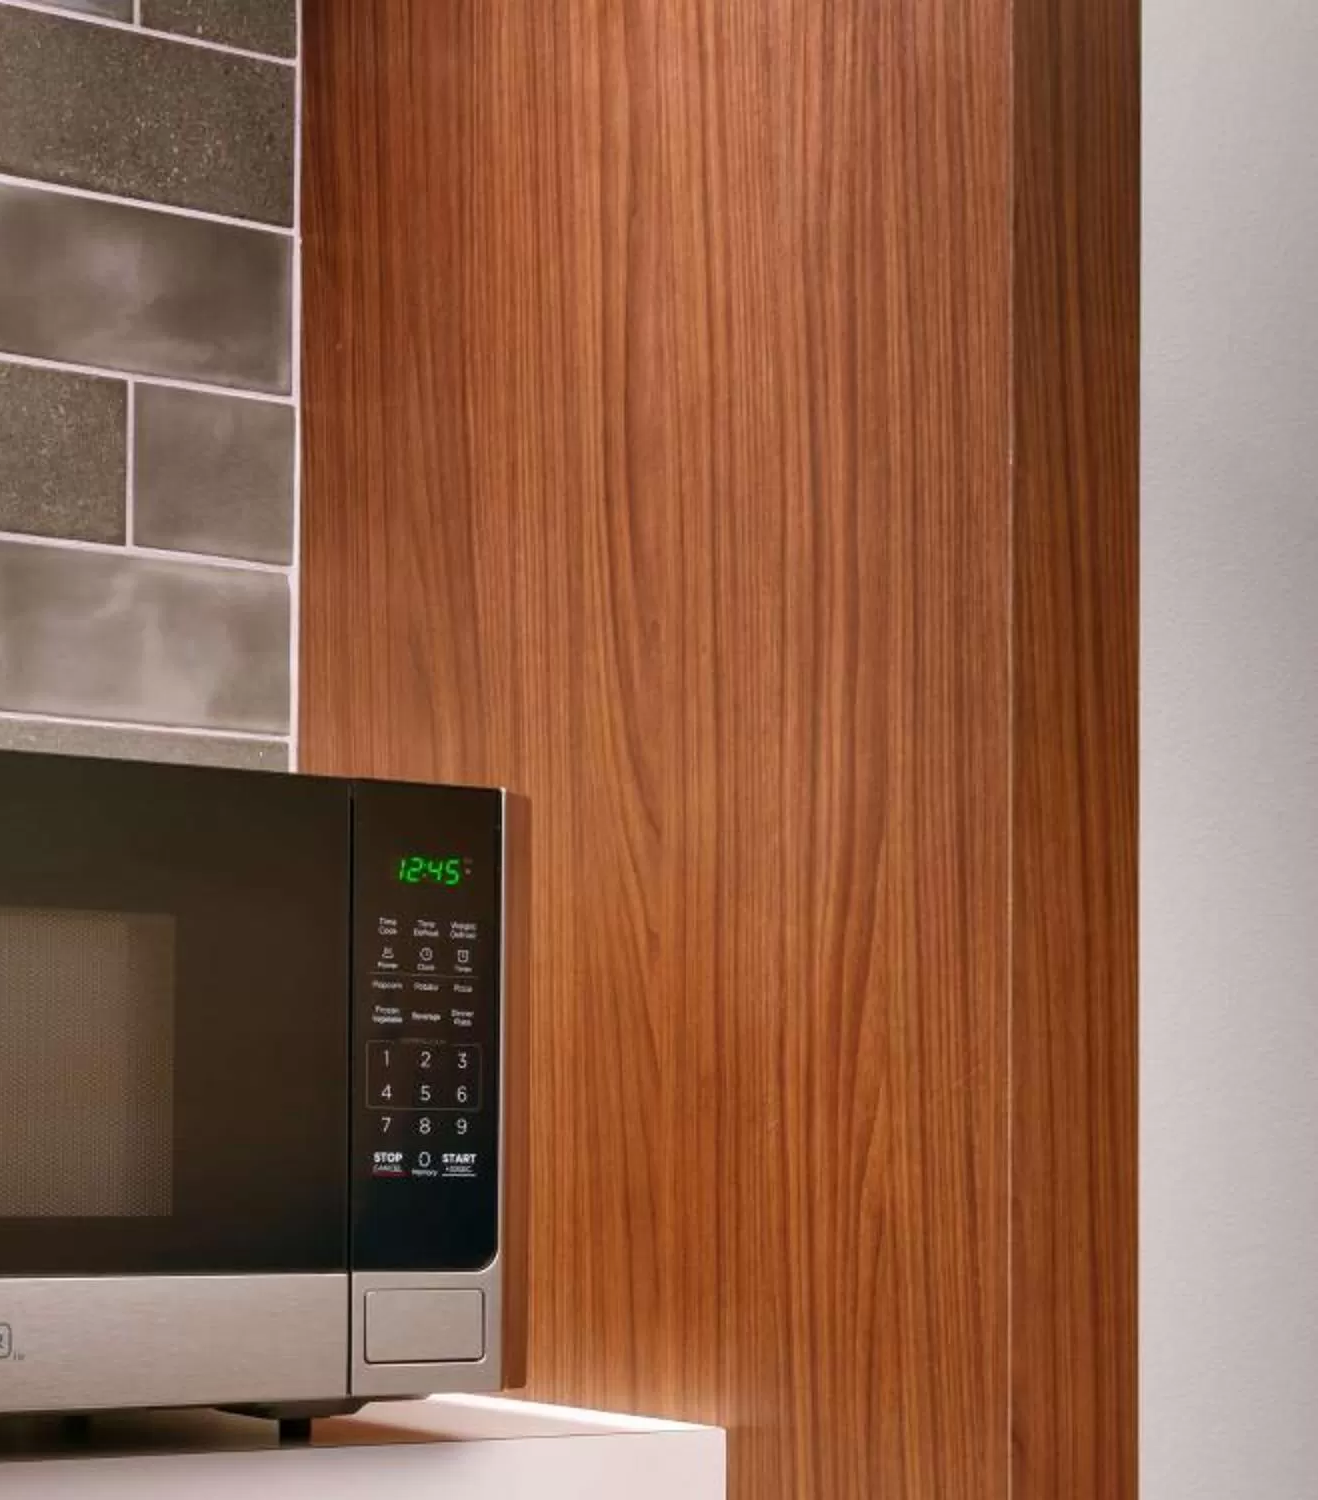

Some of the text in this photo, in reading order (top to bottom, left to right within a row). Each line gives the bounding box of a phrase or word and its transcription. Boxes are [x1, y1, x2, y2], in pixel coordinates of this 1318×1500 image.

[399, 856, 460, 885] 12:45
[384, 1050, 467, 1069] 1 2 3
[381, 1084, 467, 1102] 4 5 6
[381, 1117, 467, 1135] 7 8 9
[373, 1151, 403, 1163] STOP
[442, 1153, 477, 1164] START
